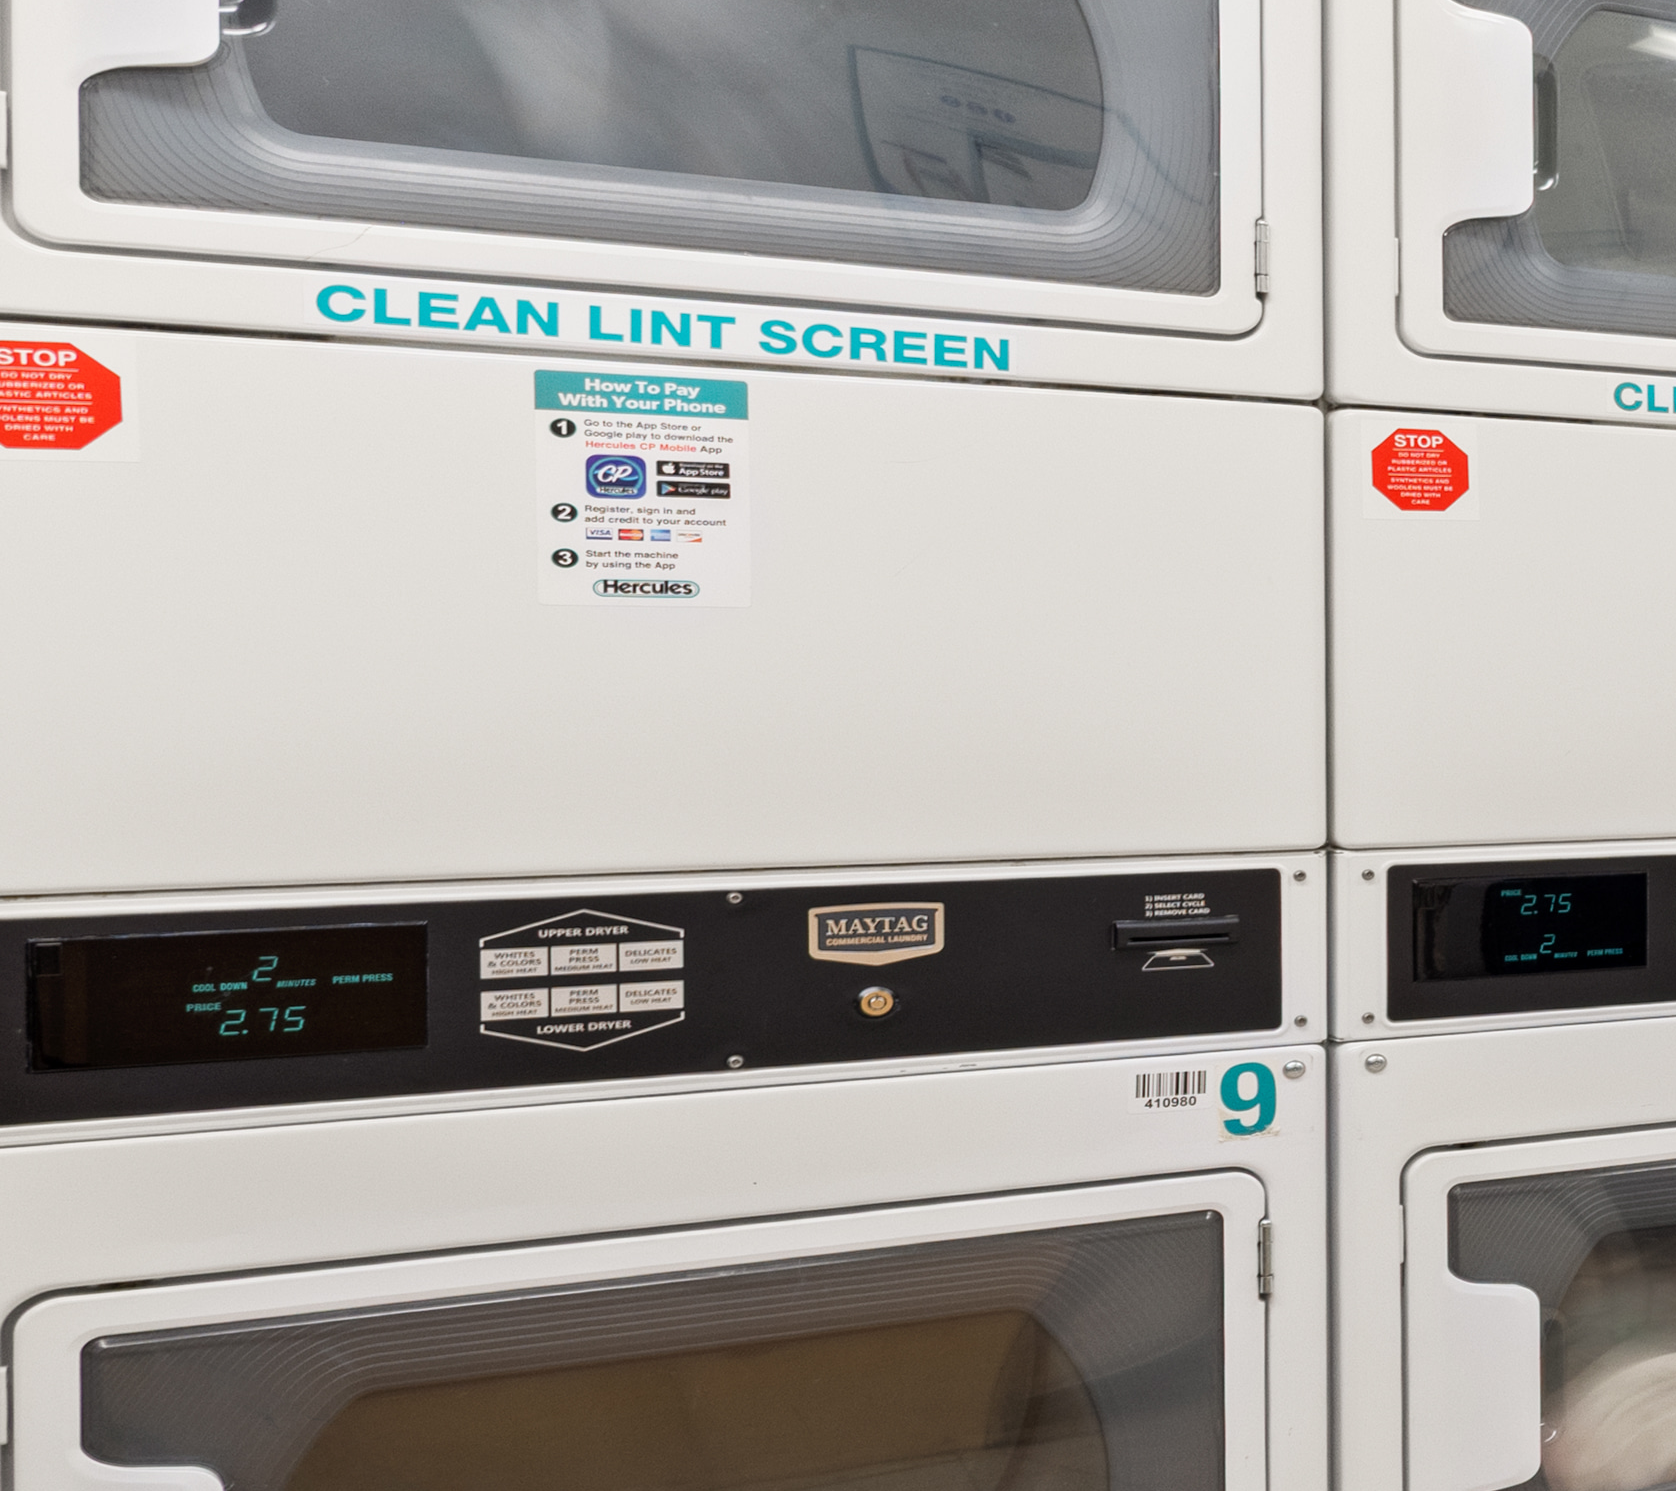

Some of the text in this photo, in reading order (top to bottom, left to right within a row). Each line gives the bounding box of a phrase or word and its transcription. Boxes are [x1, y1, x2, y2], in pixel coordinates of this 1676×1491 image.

[316, 284, 1010, 372] CLEAN LINT SCREEN
[0, 347, 77, 366] STOP
[584, 378, 700, 398] How To Pay
[558, 393, 726, 414] With Your Phone
[557, 421, 568, 435] 1
[584, 419, 599, 427] Go
[617, 421, 633, 429] the
[636, 422, 657, 430] App
[660, 422, 688, 431] Store
[585, 441, 722, 455] Hercules CP Mobile App
[1394, 434, 1444, 448] STOP
[597, 464, 633, 483] CP
[557, 505, 572, 520] 2
[558, 551, 573, 565] 3
[603, 579, 693, 595] Hercules
[1520, 893, 1572, 916] 2.75
[538, 926, 629, 938] UPPER DRYER
[826, 915, 929, 936] MAYTAG
[253, 956, 279, 982] 2
[276, 979, 317, 988] MINUTES
[332, 973, 394, 984] PERM PRESS
[192, 982, 248, 993] COOL DOWN
[186, 1002, 222, 1012] PRICE
[219, 1006, 306, 1036] 2.75
[537, 1020, 632, 1034] LOWER DRYER
[1144, 1095, 1197, 1109] 410980
[1220, 1061, 1277, 1136] 9
